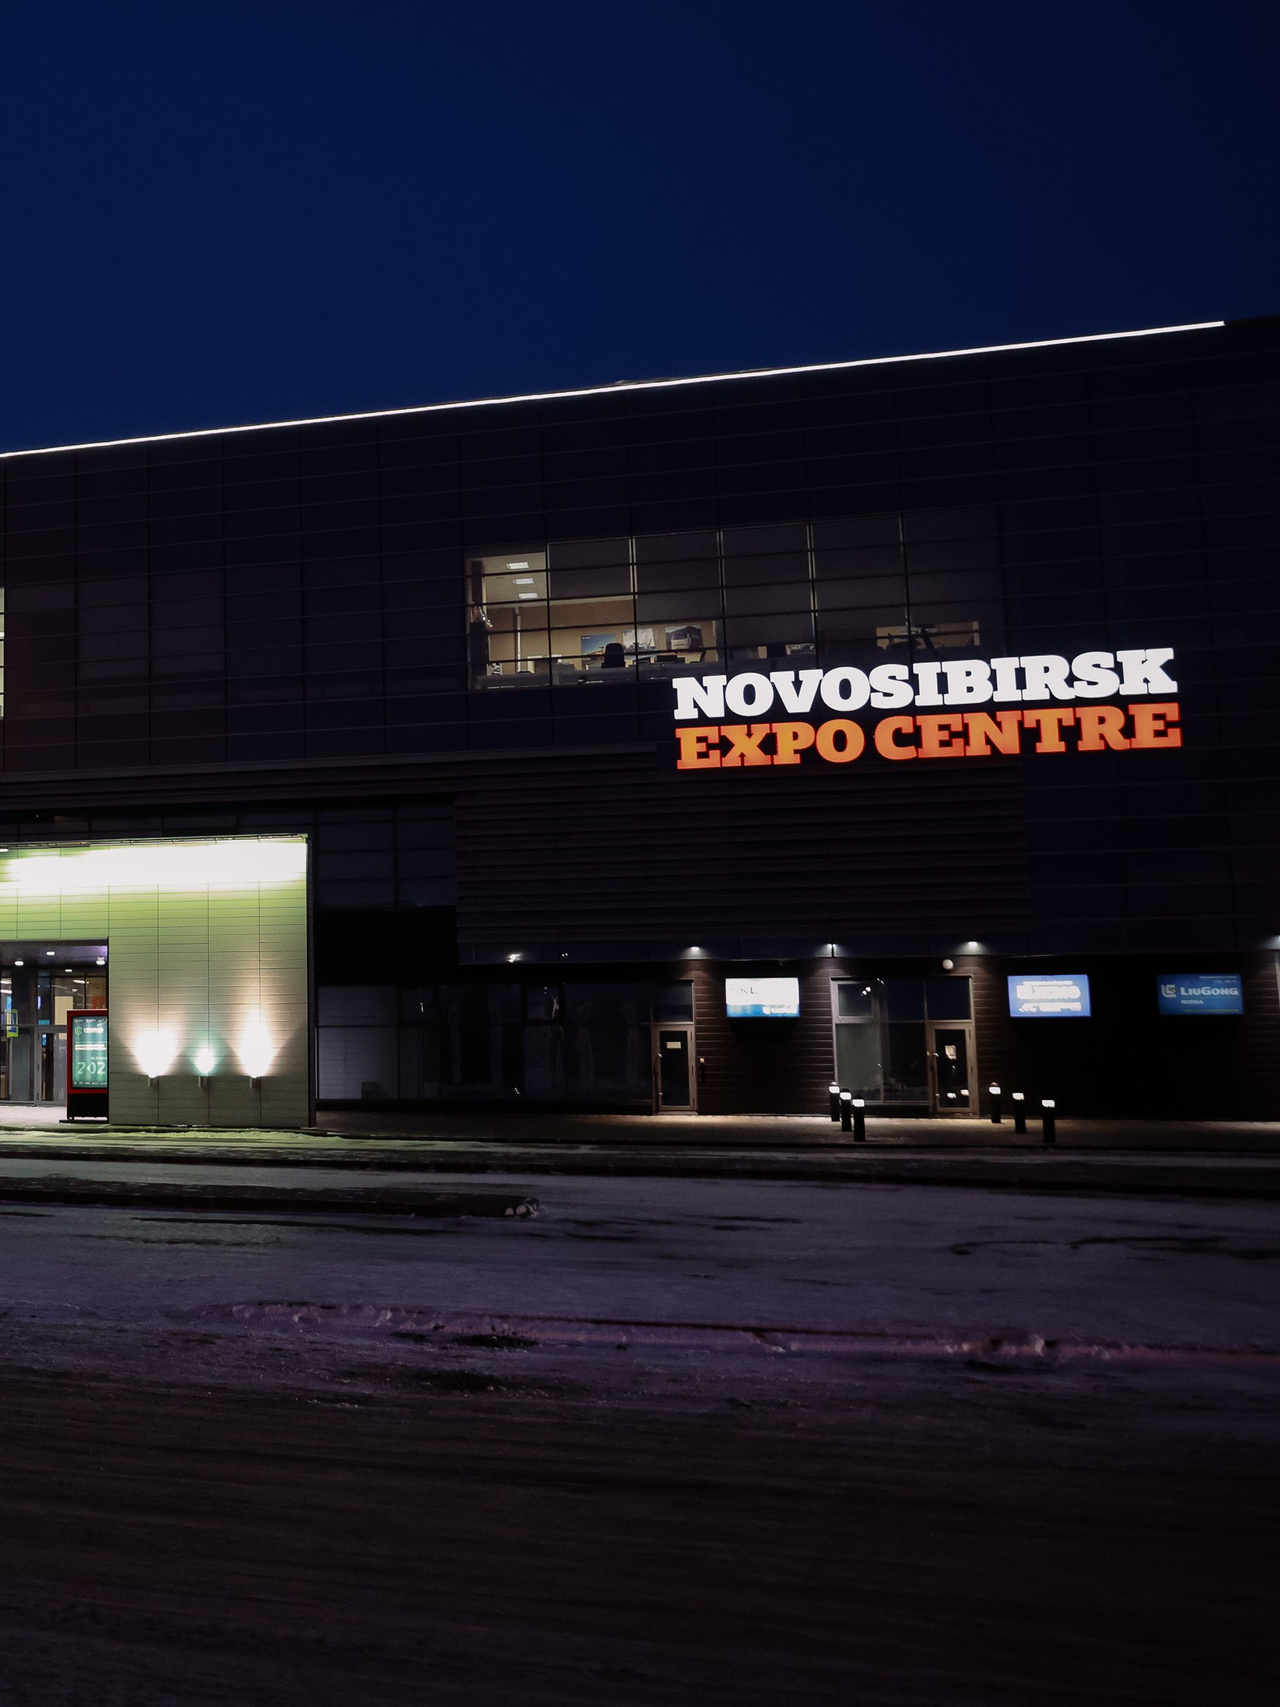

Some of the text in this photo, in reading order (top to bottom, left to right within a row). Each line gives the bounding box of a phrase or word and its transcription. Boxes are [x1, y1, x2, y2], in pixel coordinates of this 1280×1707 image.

[672, 647, 1179, 720] NOVOSIBIRSK
[675, 702, 1182, 770] EXPO CENTRE
[77, 1061, 106, 1075] 202
